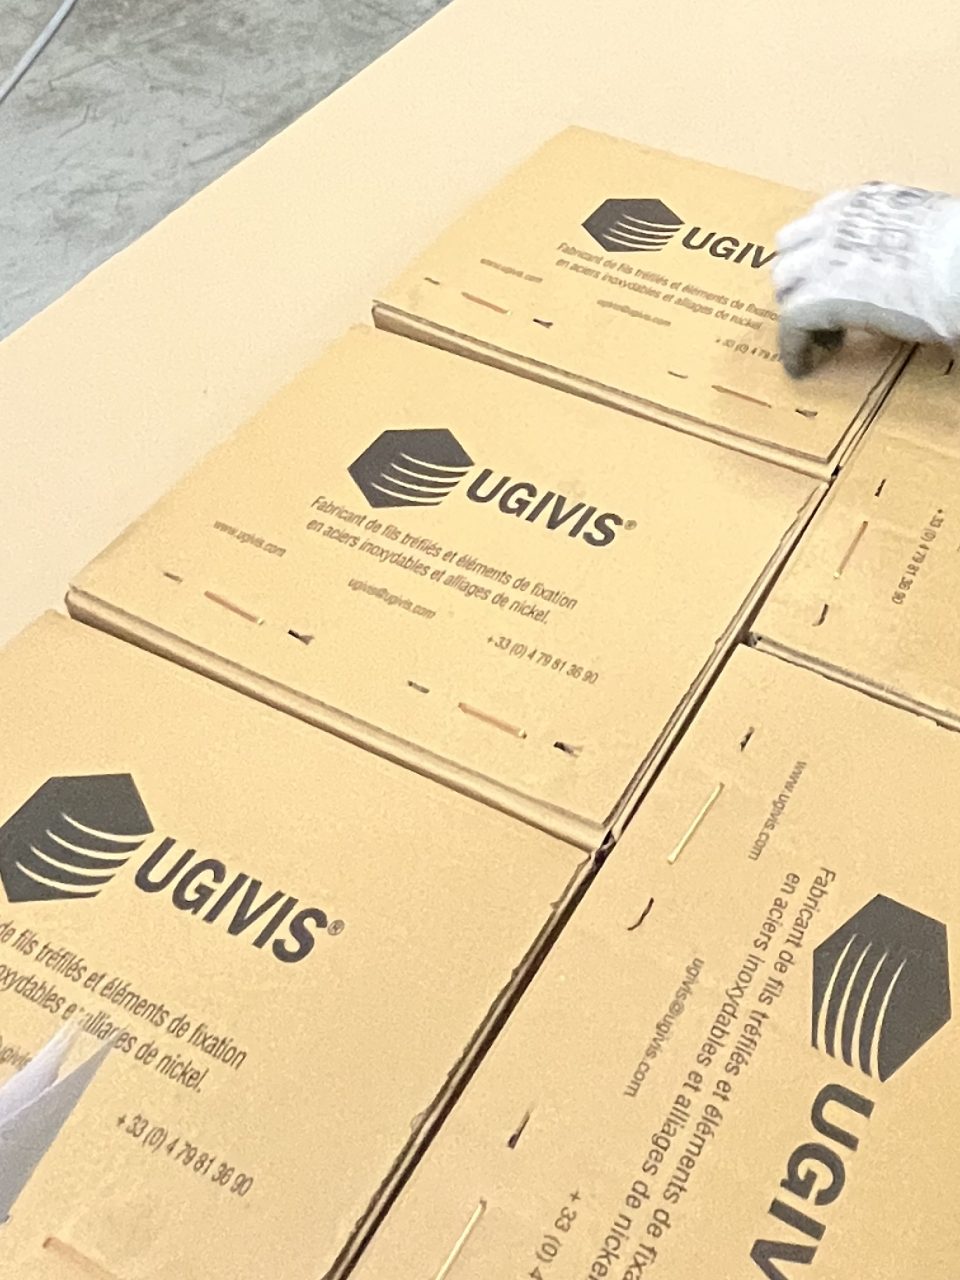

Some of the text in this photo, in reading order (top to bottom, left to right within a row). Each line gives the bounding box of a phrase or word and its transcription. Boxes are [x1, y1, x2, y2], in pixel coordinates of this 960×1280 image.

[681, 226, 777, 269] UGIV
[603, 256, 618, 270] de
[730, 297, 745, 311] de
[714, 309, 729, 322] de
[306, 519, 324, 533] en
[322, 524, 361, 548] aciers
[358, 538, 431, 577] inoxydables
[430, 569, 447, 583] et
[442, 574, 493, 602] alliages
[491, 592, 510, 608] de
[311, 495, 578, 610] Fabricant de fils tréfilés et éléments de fixation
[494, 636, 512, 651] 33
[509, 641, 529, 659] (0)
[527, 649, 538, 661] 4
[535, 651, 553, 667] 79
[551, 658, 568, 673] 81
[566, 664, 584, 679] 36
[581, 670, 599, 685] 90
[748, 760, 808, 861] www.ugivis.com
[780, 872, 801, 895] en
[784, 867, 837, 948] Fabricant
[752, 897, 789, 952] aciers
[773, 949, 795, 975] de
[11, 928, 39, 956] fils
[36, 942, 88, 983] tréfilés
[83, 971, 108, 993] et
[99, 976, 171, 1029] éléments
[167, 1014, 191, 1040] de
[187, 1021, 249, 1071] fixation
[695, 953, 766, 1067] inoxydables
[758, 976, 785, 1006] fils
[134, 1039, 159, 1066] de
[155, 1053, 210, 1094] nickel.
[724, 1009, 770, 1077] tréfilés
[682, 1070, 704, 1093] et
[712, 1078, 732, 1103] et
[116, 1113, 254, 1197] + 33 (0) 4 79 81 36 90
[641, 1094, 692, 1177] alliages
[662, 1104, 724, 1205] éléments
[569, 1190, 582, 1203] +
[625, 1180, 651, 1210] de
[749, 1083, 876, 1280] UGIV
[554, 1206, 578, 1233] 33
[646, 1208, 672, 1239] de
[535, 1234, 563, 1264] (0)
